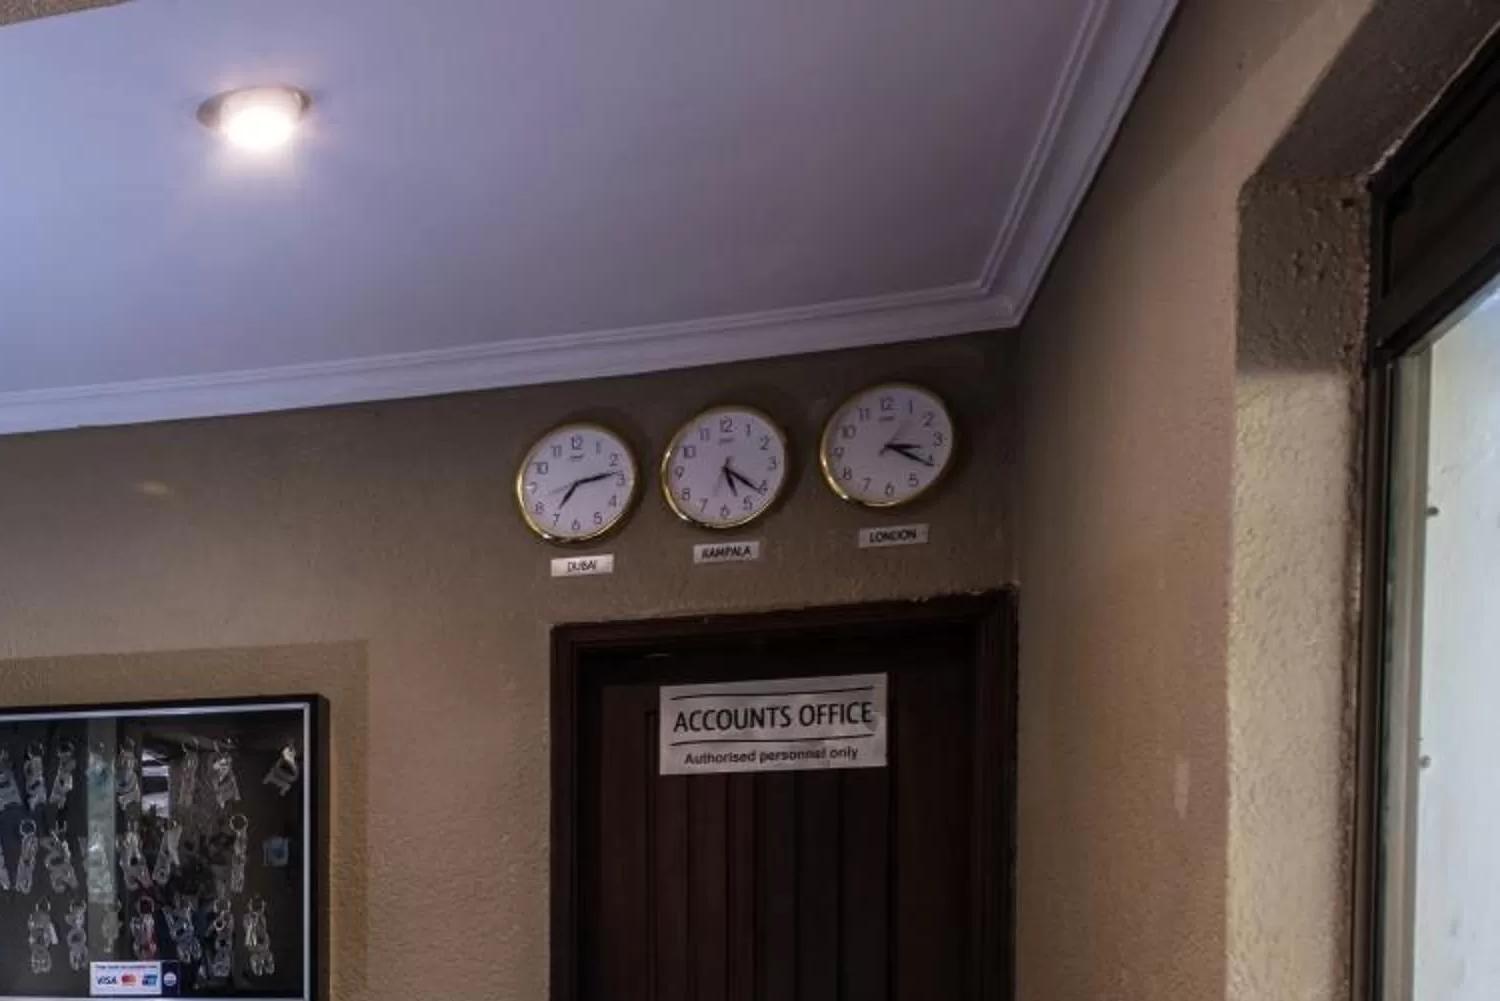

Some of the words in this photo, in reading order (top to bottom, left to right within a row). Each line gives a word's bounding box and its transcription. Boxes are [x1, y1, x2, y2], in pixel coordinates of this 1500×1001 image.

[869, 529, 917, 543] LONDON
[567, 560, 597, 573] DUBAI
[673, 705, 792, 733] ACCOUNTS
[799, 701, 873, 728] OFFICE
[684, 750, 756, 765] Authorised
[829, 746, 859, 762] only
